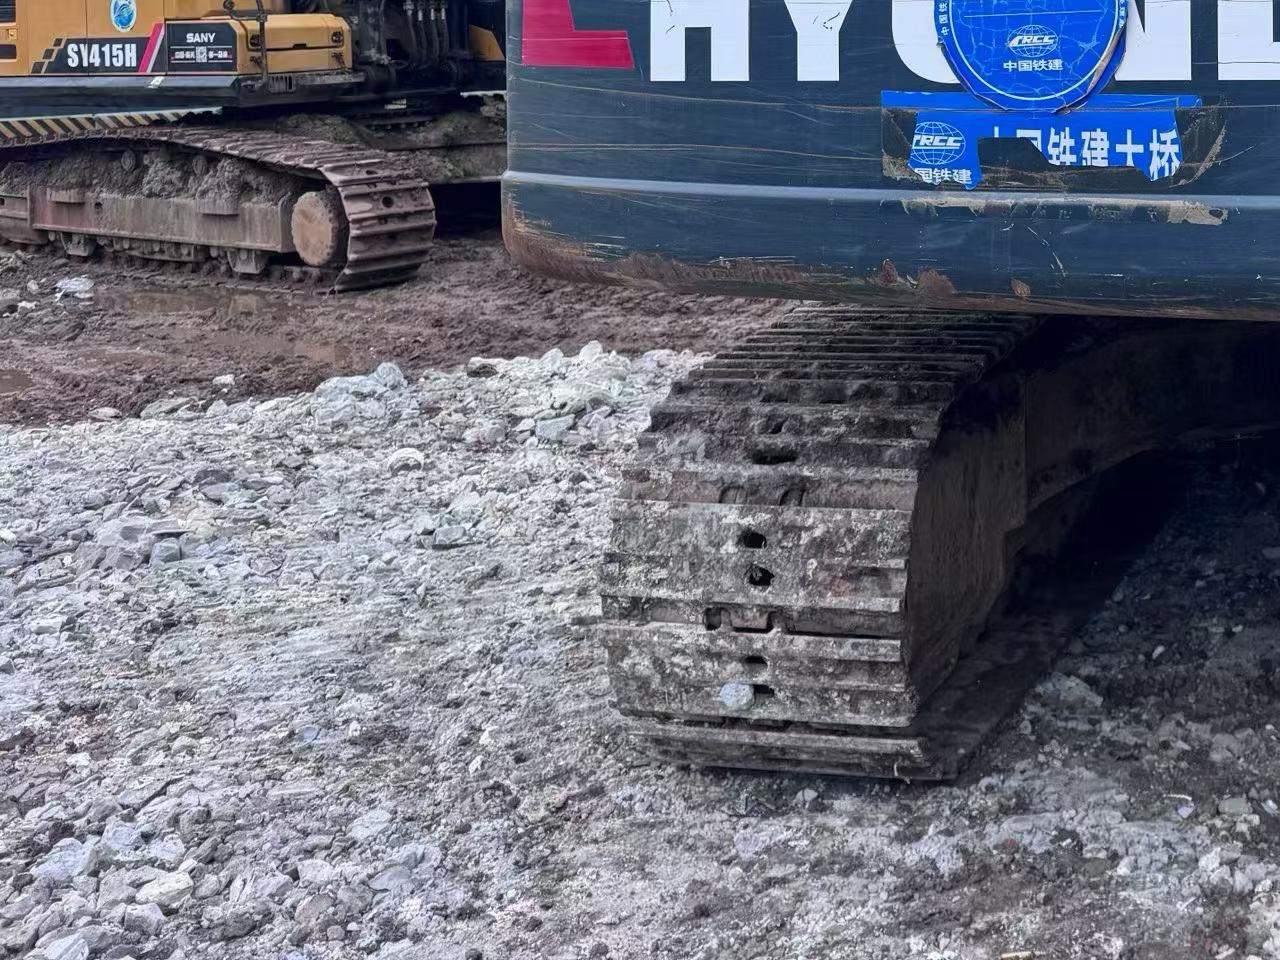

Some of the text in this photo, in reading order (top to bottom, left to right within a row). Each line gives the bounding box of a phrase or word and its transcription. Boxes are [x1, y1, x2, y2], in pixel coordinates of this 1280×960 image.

[185, 32, 216, 44] SANY
[66, 43, 137, 69] SY415H
[1002, 58, 1064, 73] 中国铁建
